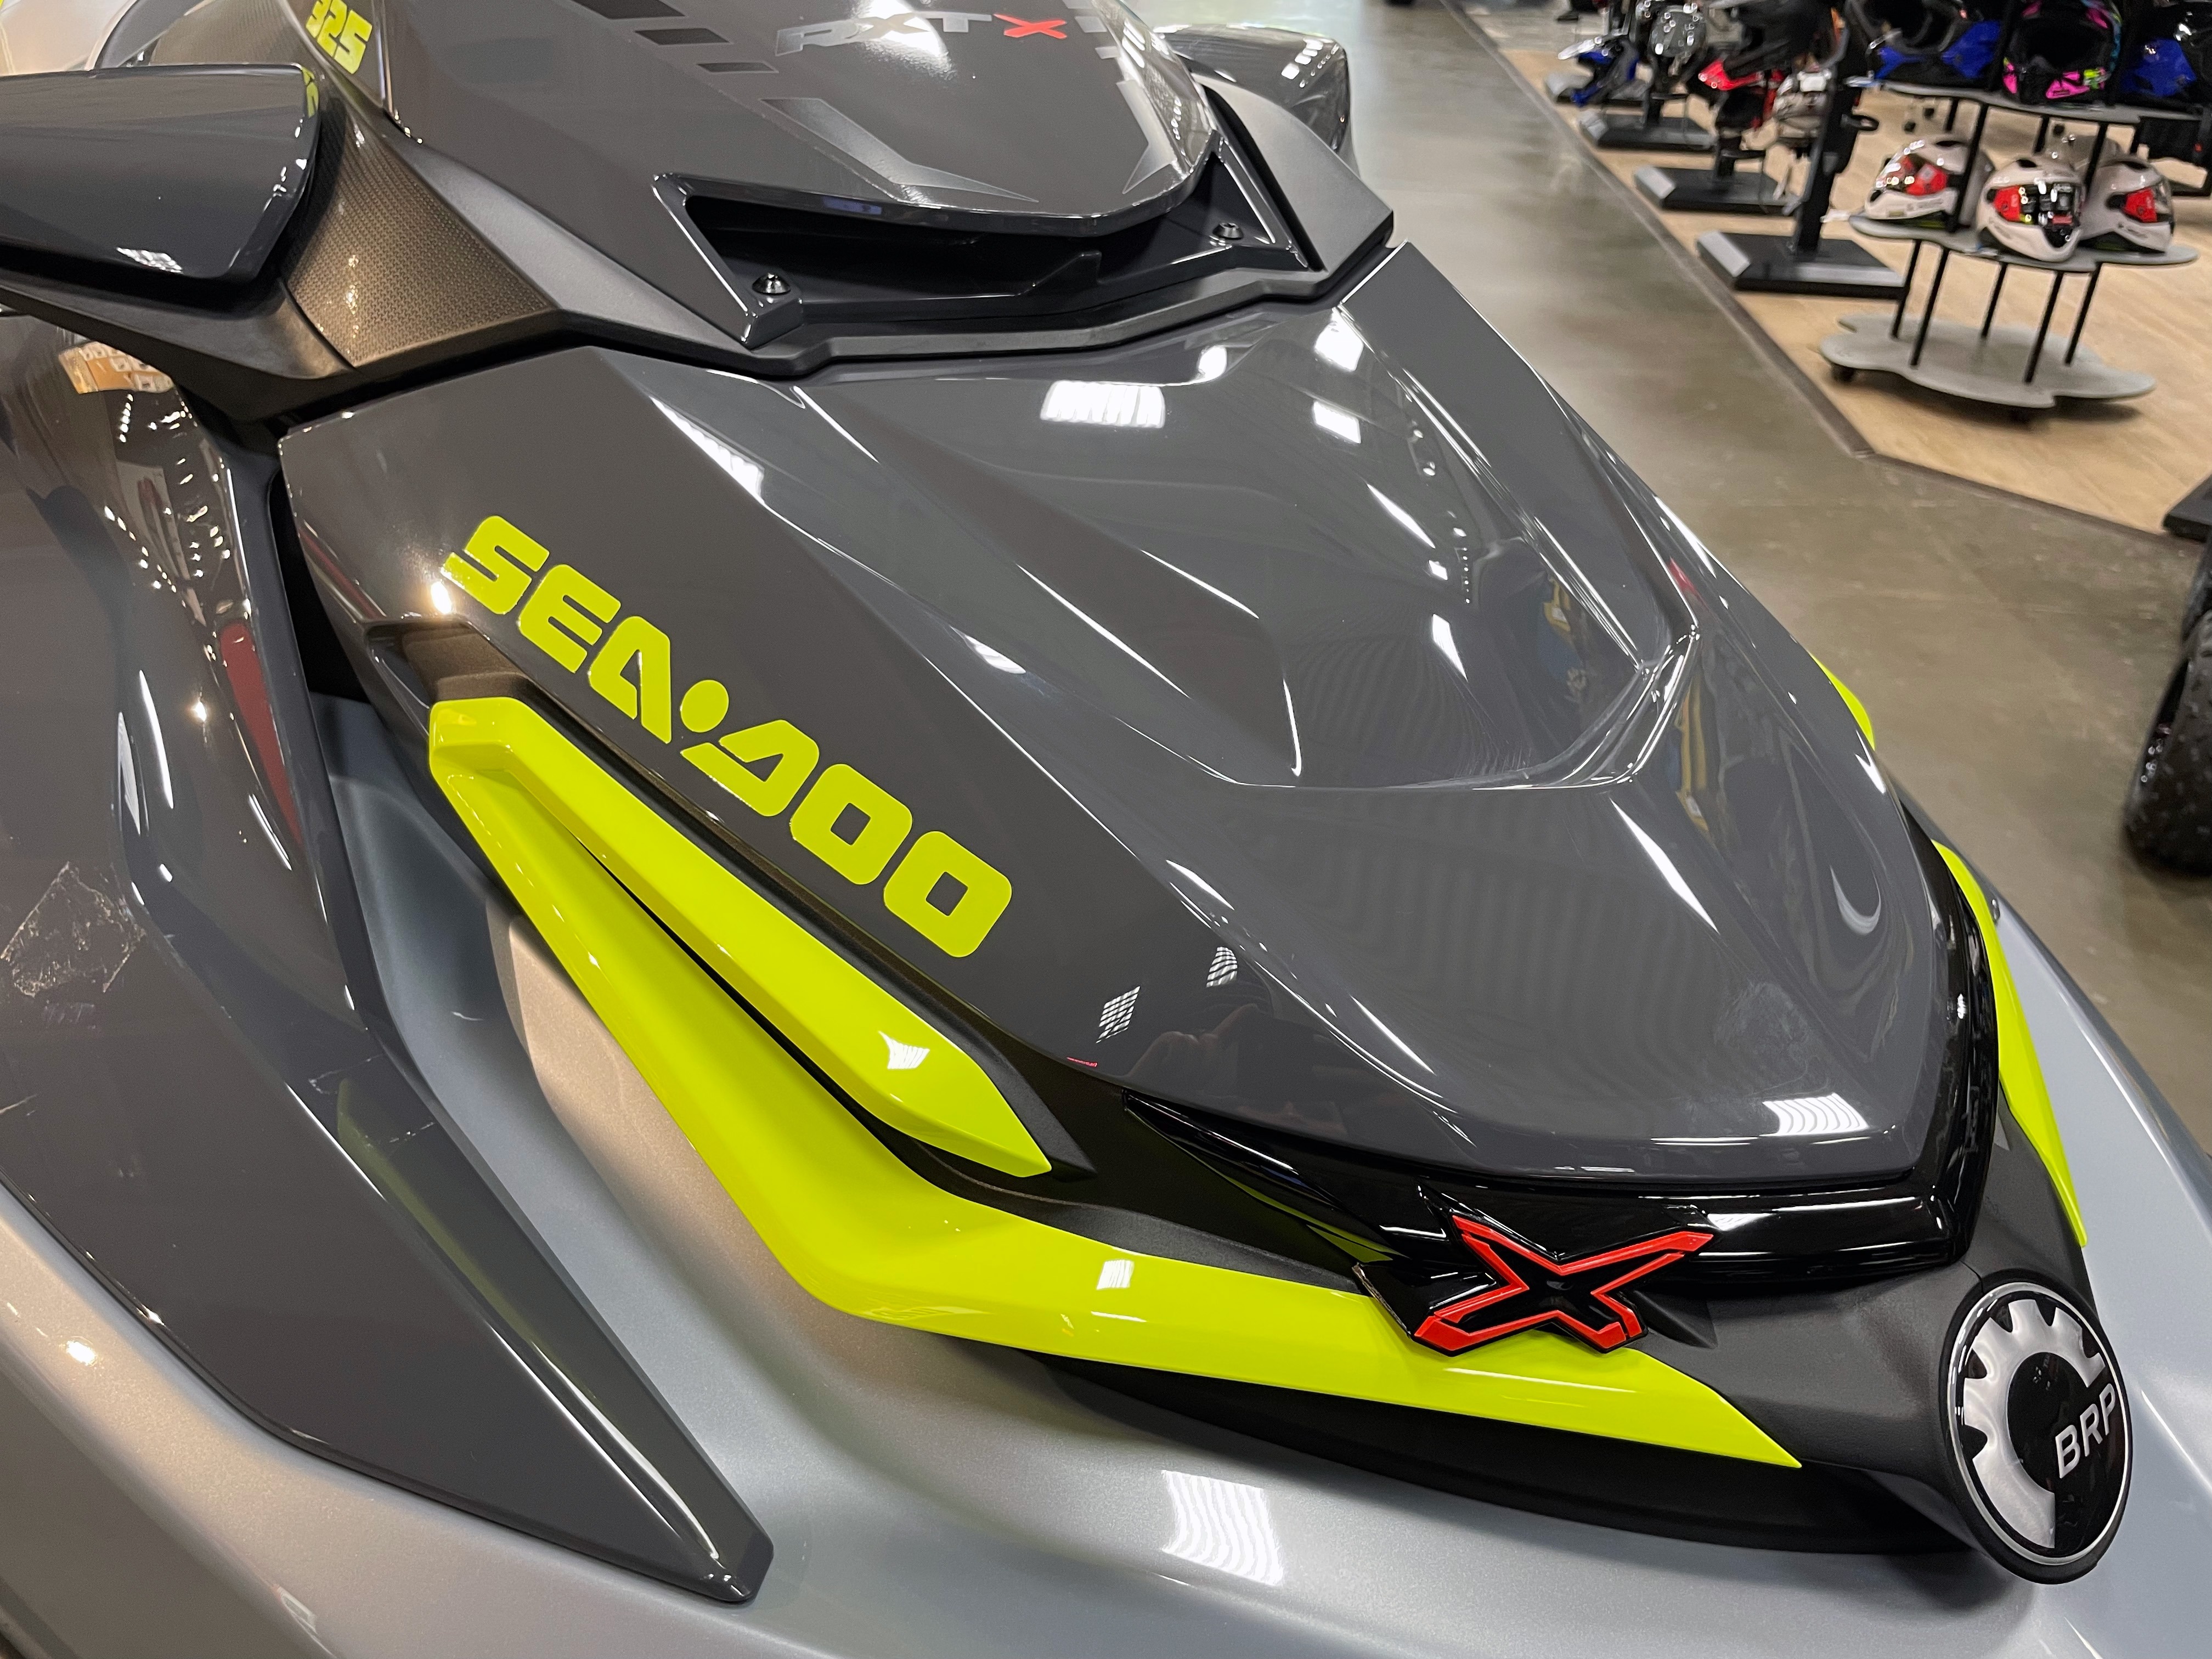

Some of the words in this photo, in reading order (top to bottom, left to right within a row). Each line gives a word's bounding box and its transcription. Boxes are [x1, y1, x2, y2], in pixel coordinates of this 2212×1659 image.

[306, 0, 373, 74] 325
[992, 13, 1067, 38] X
[2055, 1383, 2115, 1479] BRP
